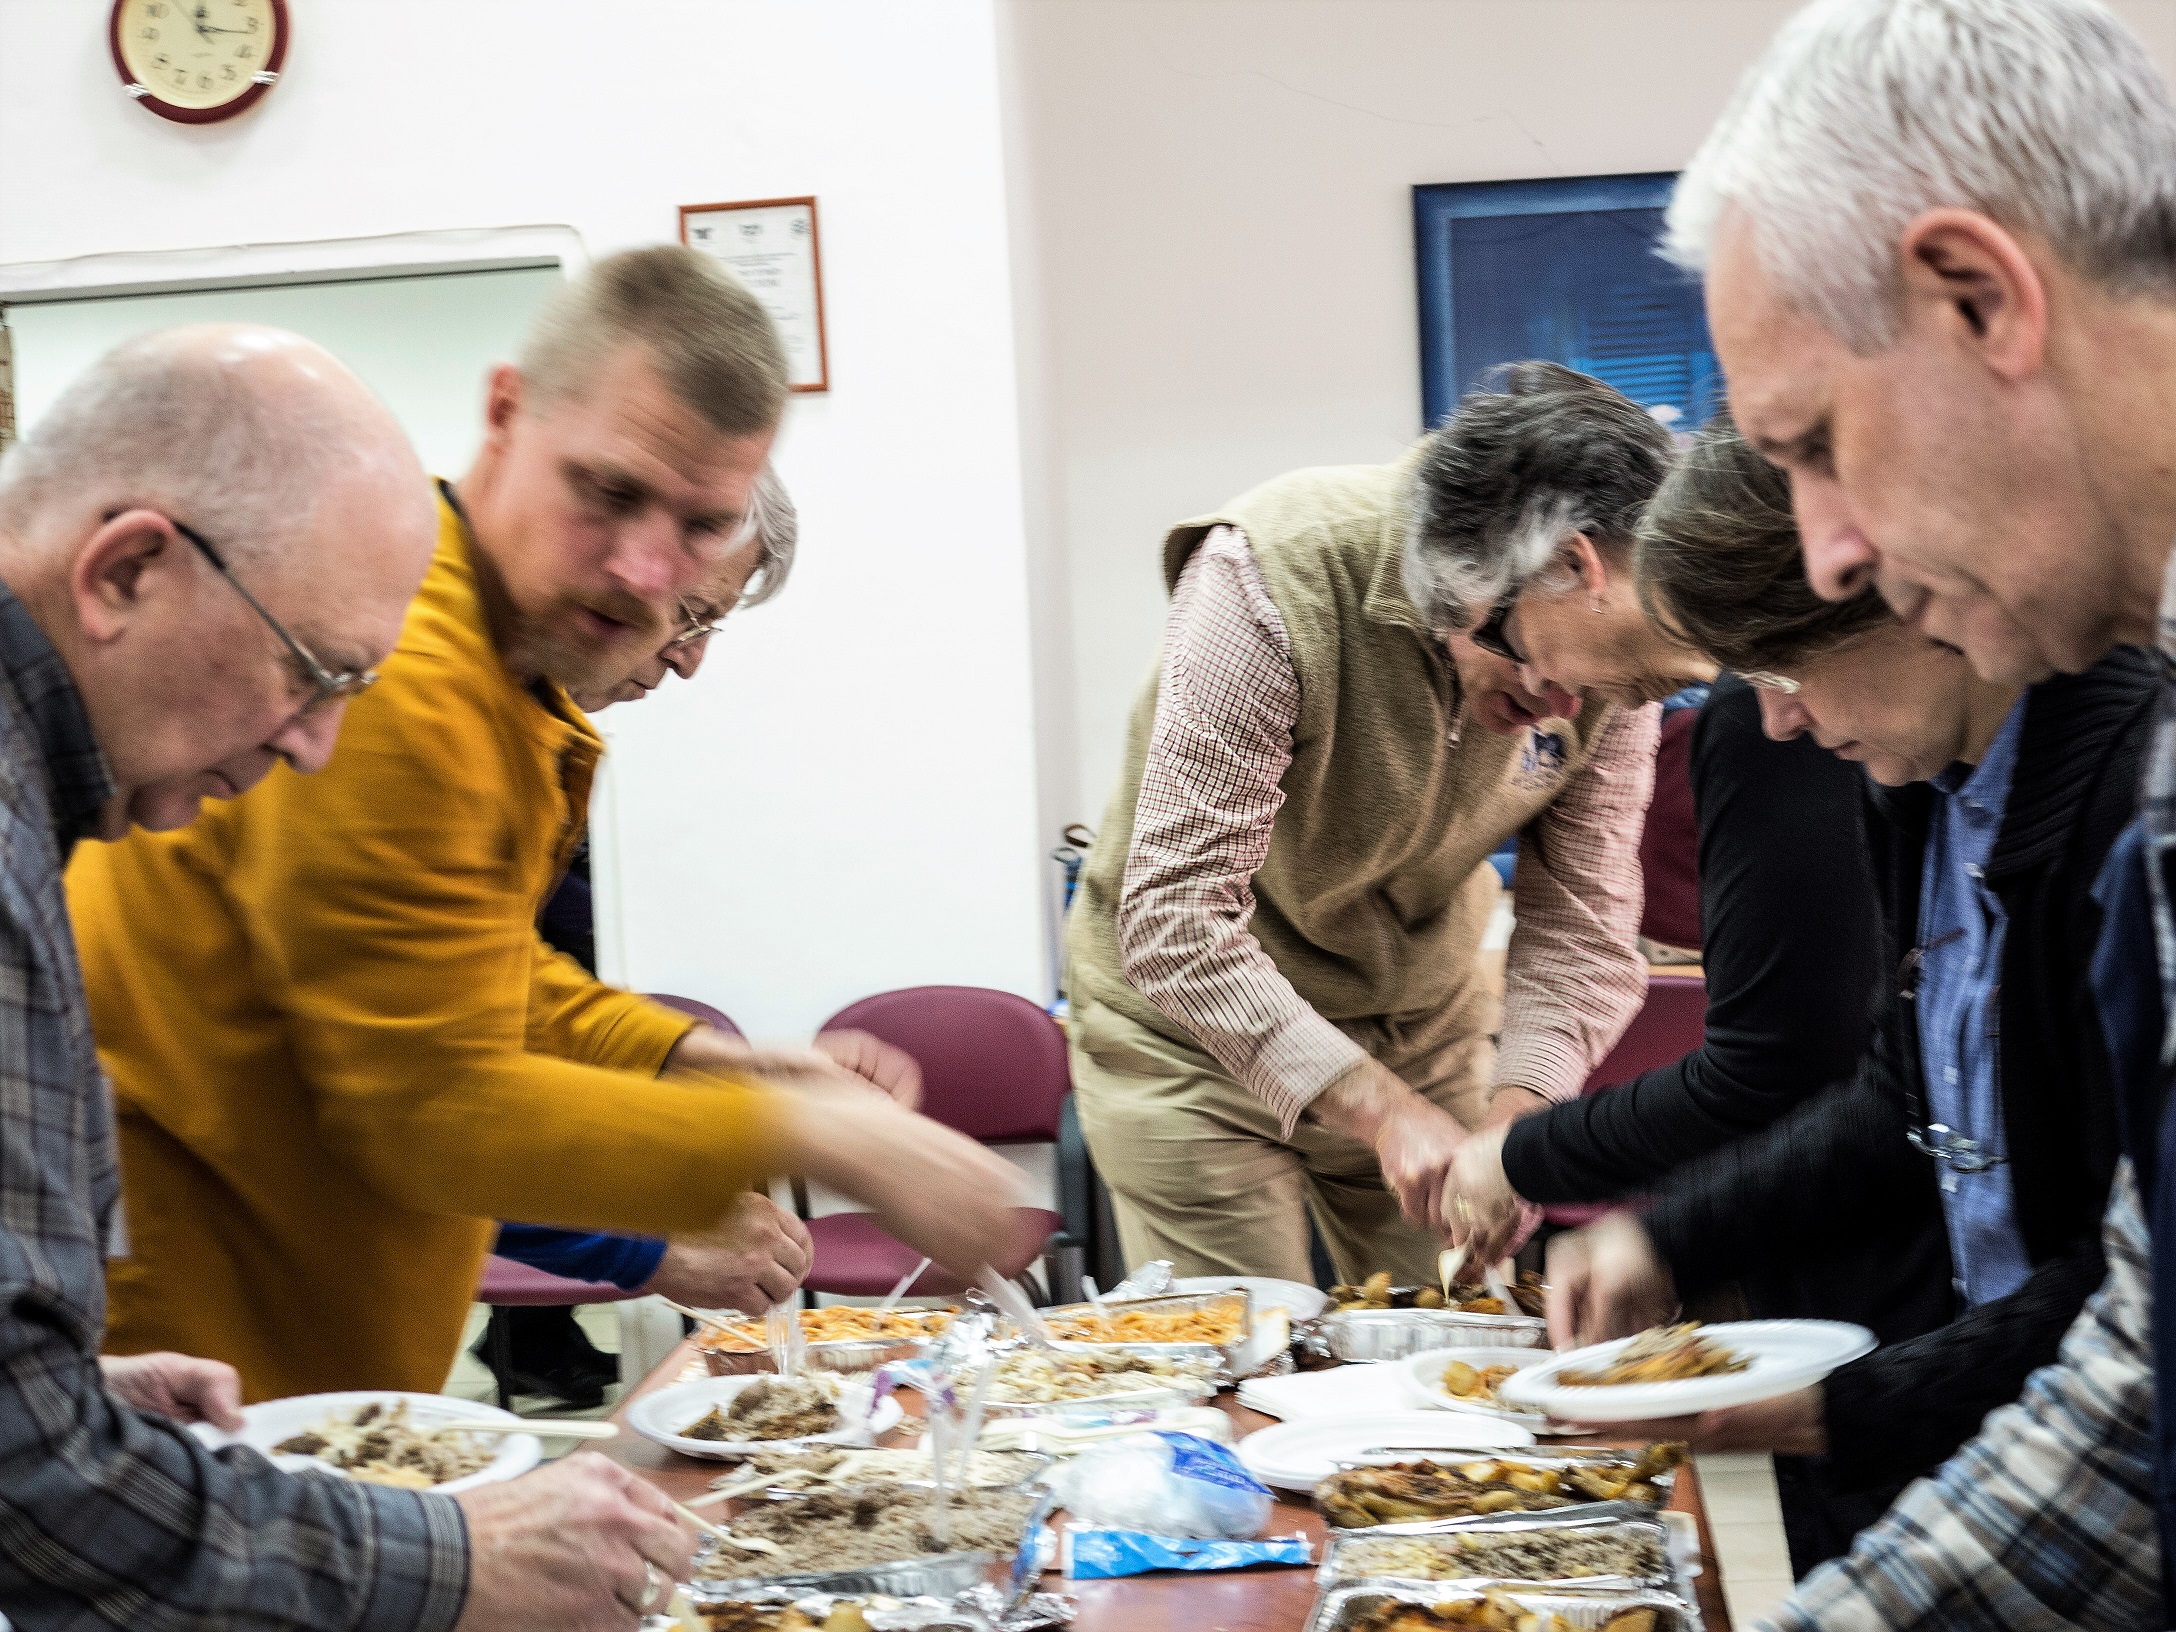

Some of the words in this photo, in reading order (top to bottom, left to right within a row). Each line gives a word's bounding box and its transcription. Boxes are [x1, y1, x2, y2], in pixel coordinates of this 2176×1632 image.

[174, 67, 187, 85] 7
[219, 63, 237, 80] 5
[196, 72, 213, 90] 6
